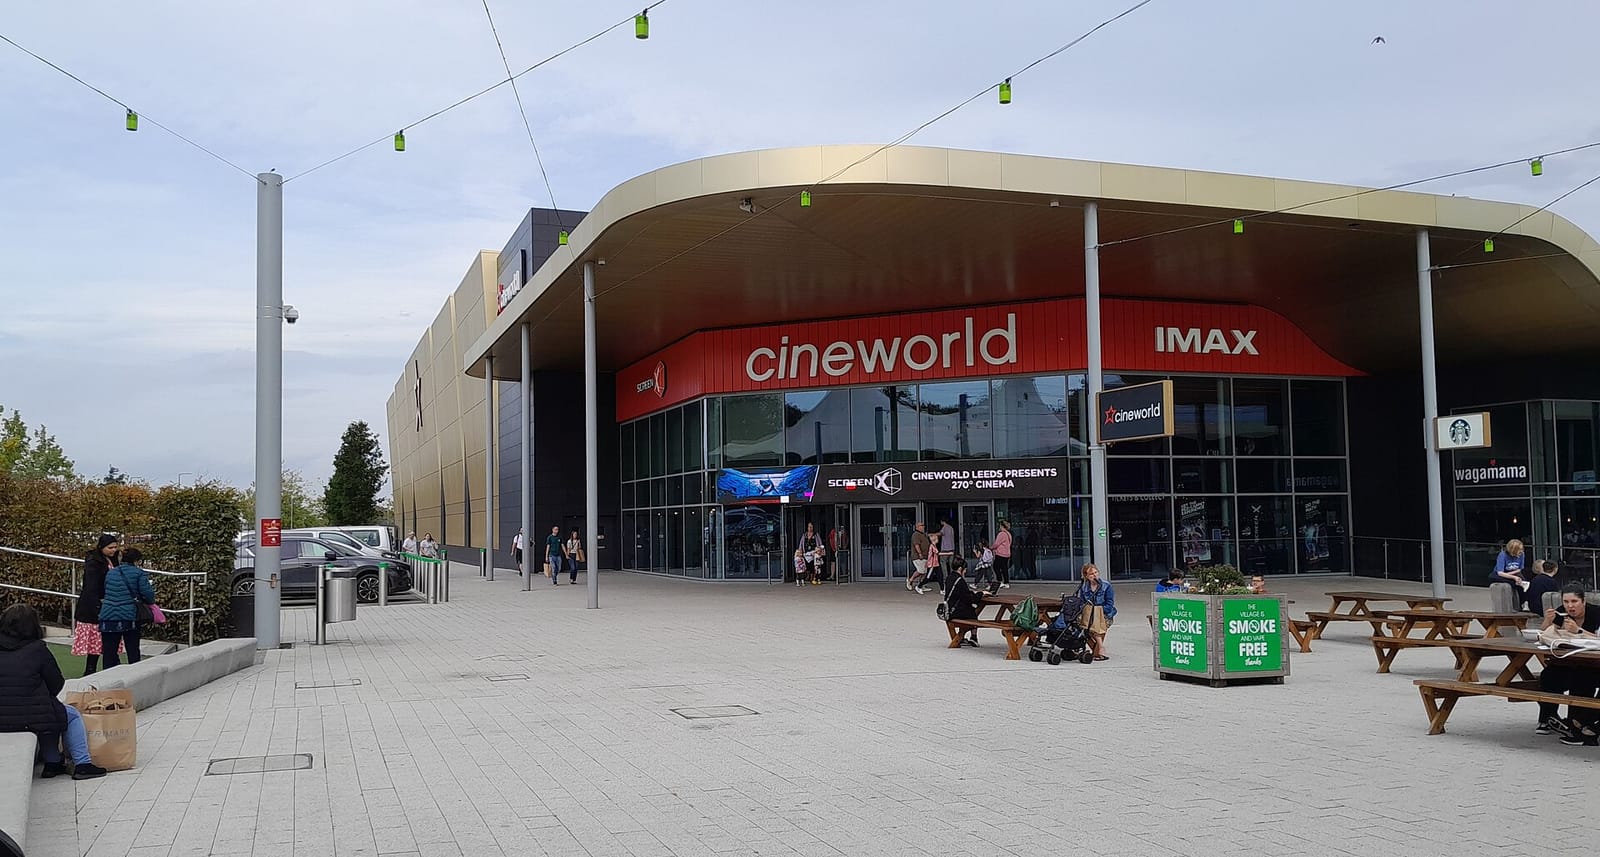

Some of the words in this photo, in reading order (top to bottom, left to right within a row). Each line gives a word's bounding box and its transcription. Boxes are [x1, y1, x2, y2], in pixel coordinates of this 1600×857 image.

[745, 312, 1018, 381] cineworld
[1154, 326, 1259, 355] IMAX
[1114, 402, 1161, 423] cineworld
[911, 470, 970, 481] CINEWORLD
[972, 469, 1003, 480] LEEDS
[1005, 467, 1058, 478] PRESENTS
[1455, 465, 1527, 483] wagamama
[951, 480, 974, 490] 270°
[976, 480, 1015, 489] CINEMA
[1163, 618, 1202, 634] SMOKE
[1229, 619, 1276, 634] SMOKE
[1170, 640, 1195, 657] FREE
[1239, 642, 1268, 657] FREE
[1174, 656, 1190, 665] thanks
[1245, 657, 1262, 666] thanks
